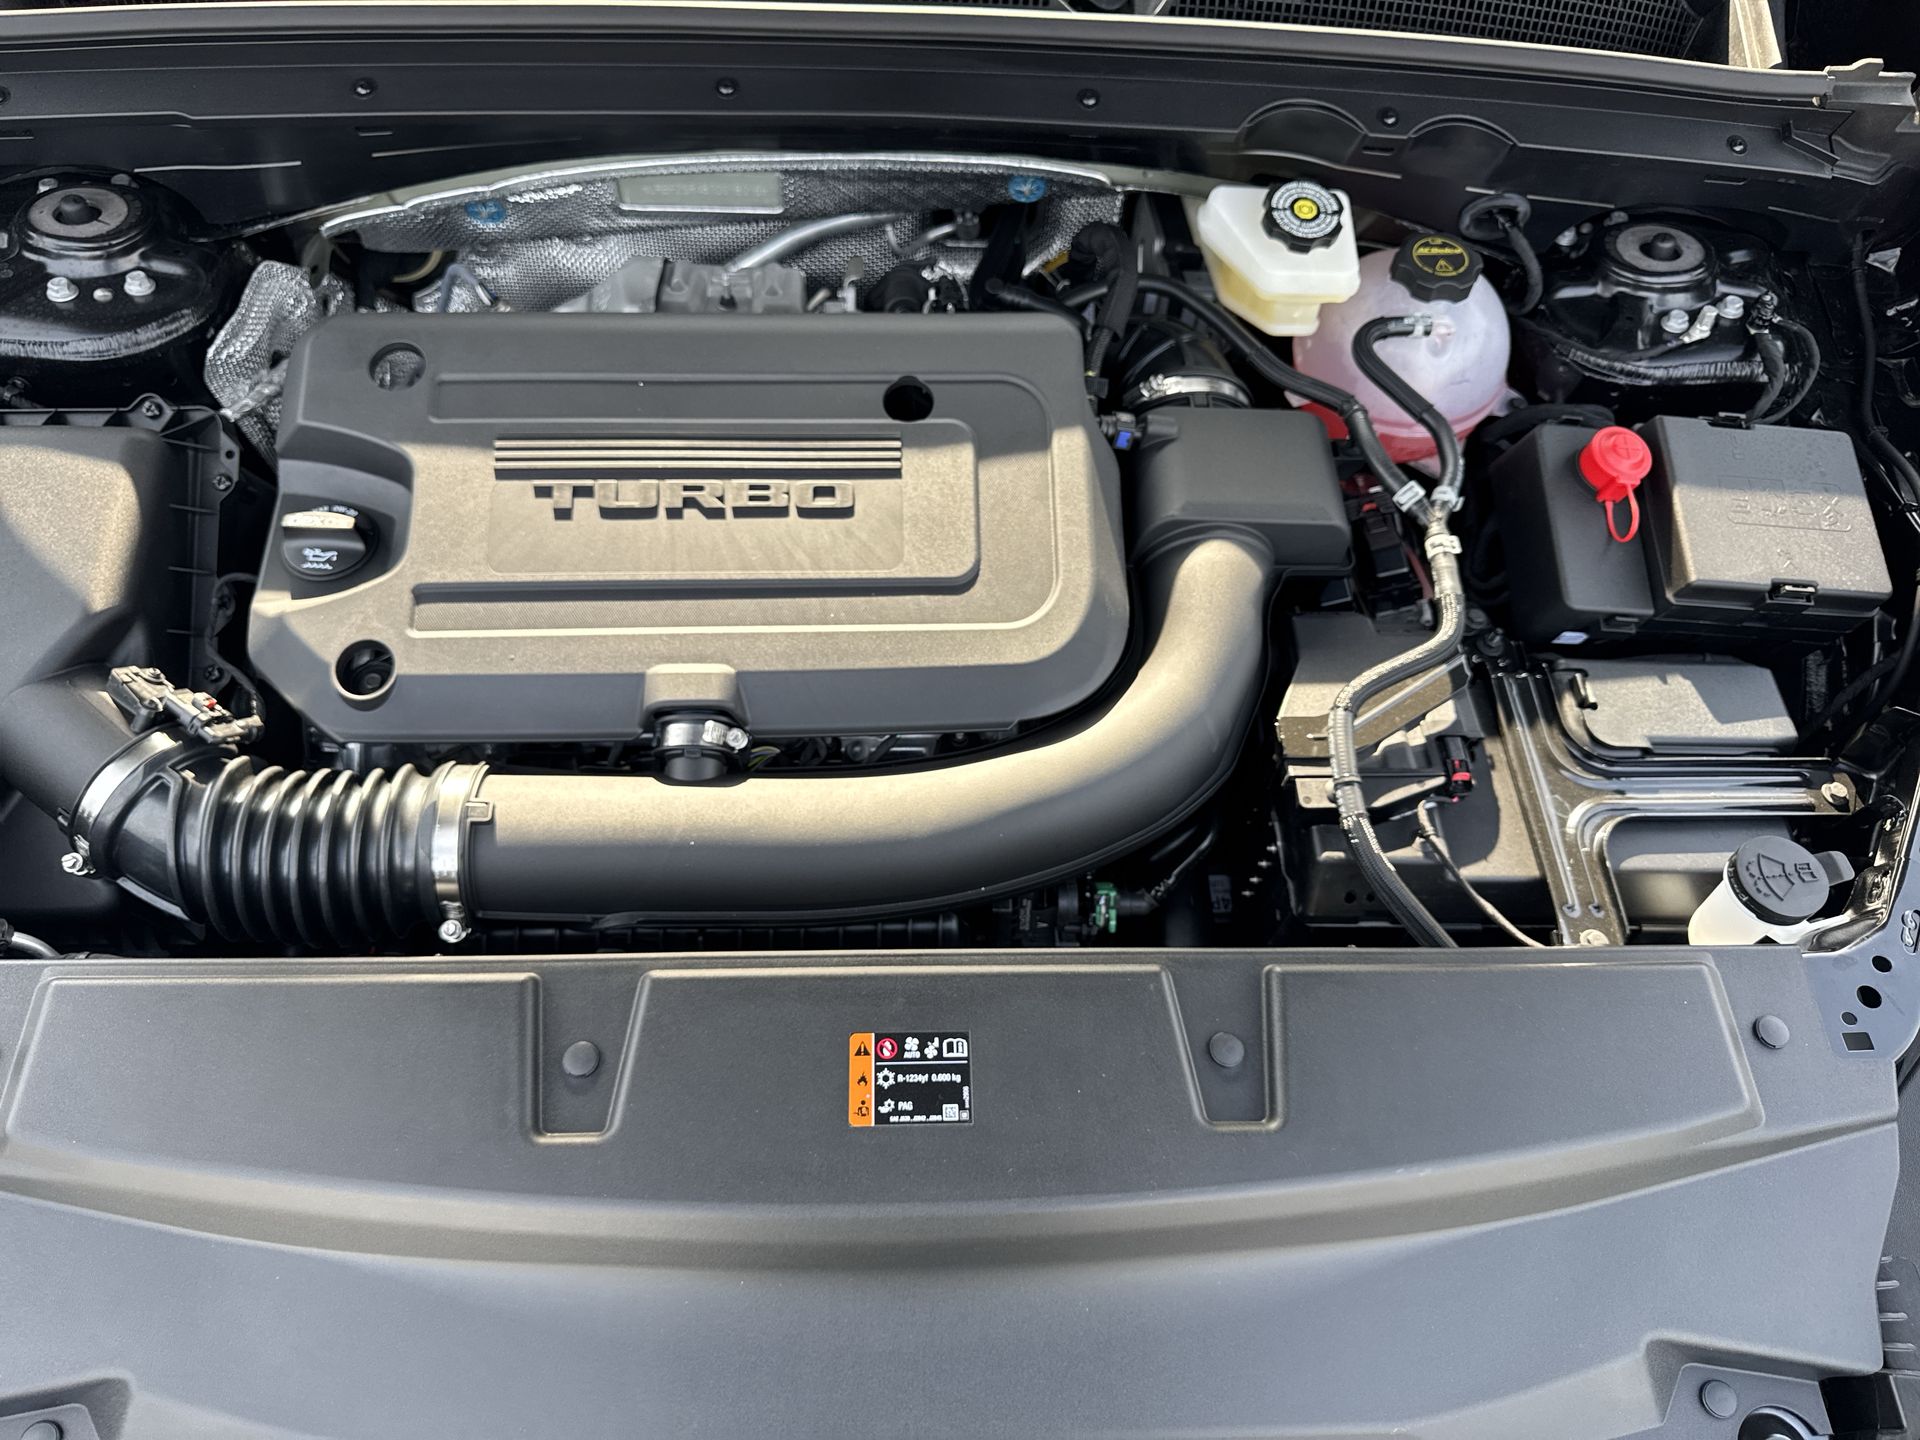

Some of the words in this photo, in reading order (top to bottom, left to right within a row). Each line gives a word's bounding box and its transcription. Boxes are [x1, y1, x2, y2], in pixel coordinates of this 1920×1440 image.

[532, 479, 855, 520] TURBO
[903, 1051, 921, 1059] AUTO
[952, 1073, 962, 1084] kg
[897, 1101, 914, 1111] PAG
